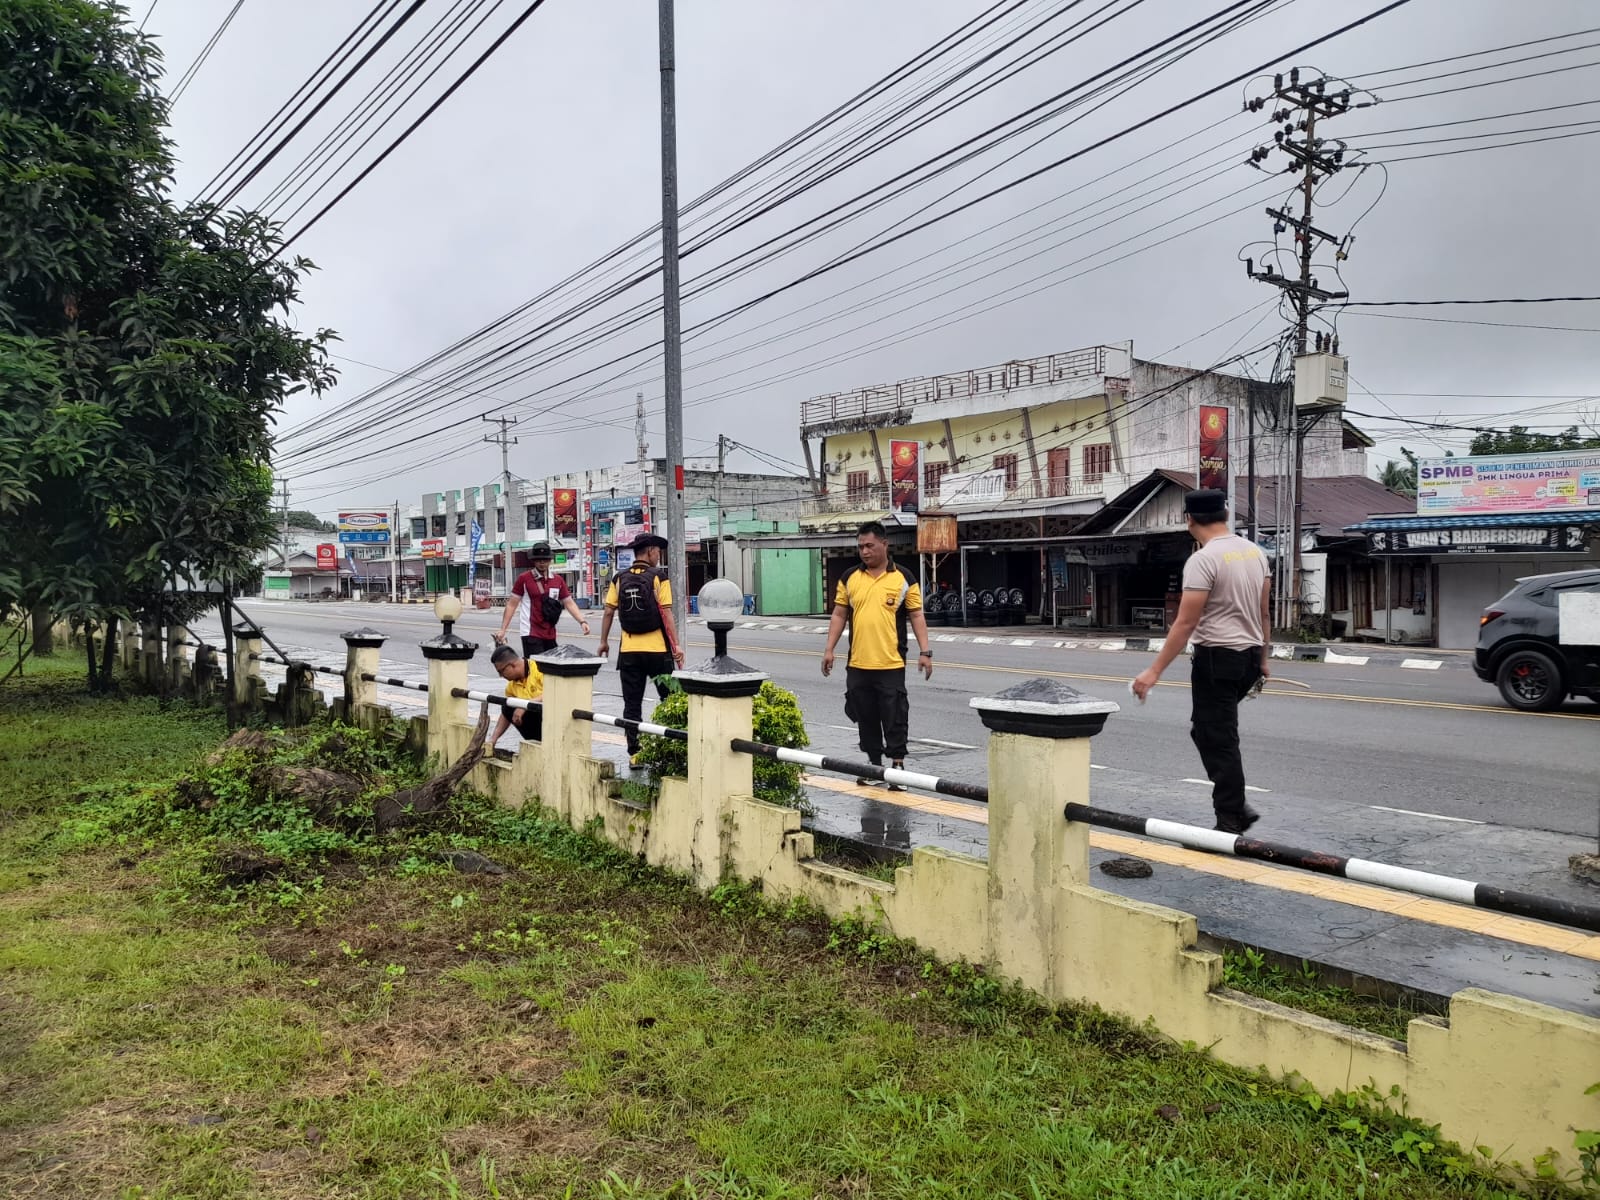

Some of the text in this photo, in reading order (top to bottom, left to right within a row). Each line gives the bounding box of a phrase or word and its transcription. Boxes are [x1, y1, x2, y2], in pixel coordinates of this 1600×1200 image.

[1505, 461, 1554, 471] PENERIMAAN
[1555, 459, 1582, 468] MURID
[1421, 466, 1473, 479] SPMB
[1499, 472, 1535, 480] LINGUA
[1538, 470, 1570, 478] PRIMA
[1406, 529, 1548, 547] WAN'S BARBERSHOP
